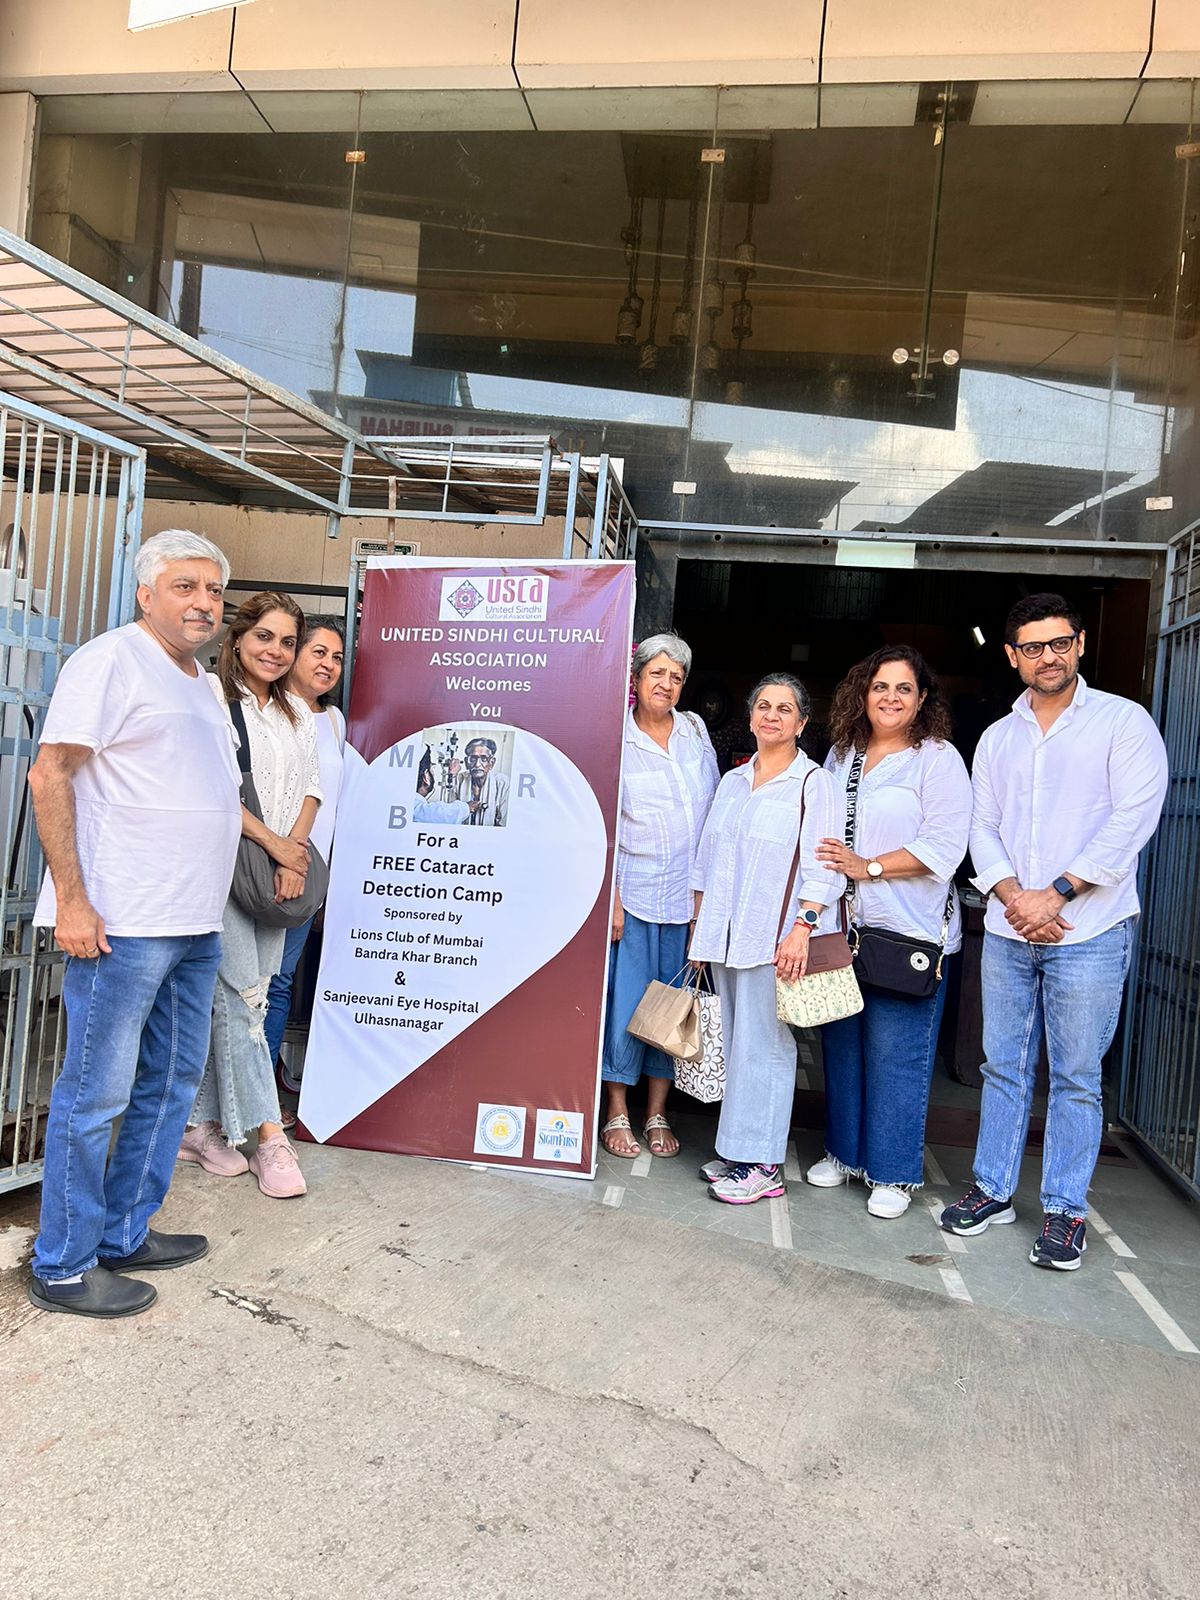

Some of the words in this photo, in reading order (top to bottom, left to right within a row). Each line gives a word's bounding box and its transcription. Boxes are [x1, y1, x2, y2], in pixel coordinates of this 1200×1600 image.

[485, 605, 514, 613] United
[515, 605, 542, 613] Sindhi
[380, 627, 444, 642] UNITED
[447, 628, 508, 643] SINDHI
[512, 628, 605, 644] CULTURAL
[429, 652, 548, 668] ASSOCIATION
[445, 676, 532, 692] Welcomes
[469, 702, 502, 718] You
[388, 744, 415, 768] M
[517, 773, 537, 799] R
[847, 766, 861, 789] LOLA
[388, 805, 408, 830] B
[416, 832, 446, 848] For
[448, 836, 459, 849] a
[372, 855, 416, 872] FREE
[420, 858, 495, 877] Cataract
[362, 880, 448, 900] Detection
[452, 886, 503, 907] Camp
[383, 907, 445, 922] Sponsored
[448, 911, 463, 925] by
[350, 928, 383, 942] Lions
[385, 930, 414, 944] Club
[417, 931, 431, 945] of
[433, 934, 484, 948] Mumbai
[354, 947, 399, 961] Bandra
[401, 949, 430, 963] Khar
[433, 951, 478, 966] Branch
[393, 970, 406, 986] &
[323, 990, 394, 1007] Sanjeevani
[396, 995, 421, 1011] Eye
[423, 998, 480, 1015] Hospital
[353, 1012, 444, 1032] Ulhasnanagar
